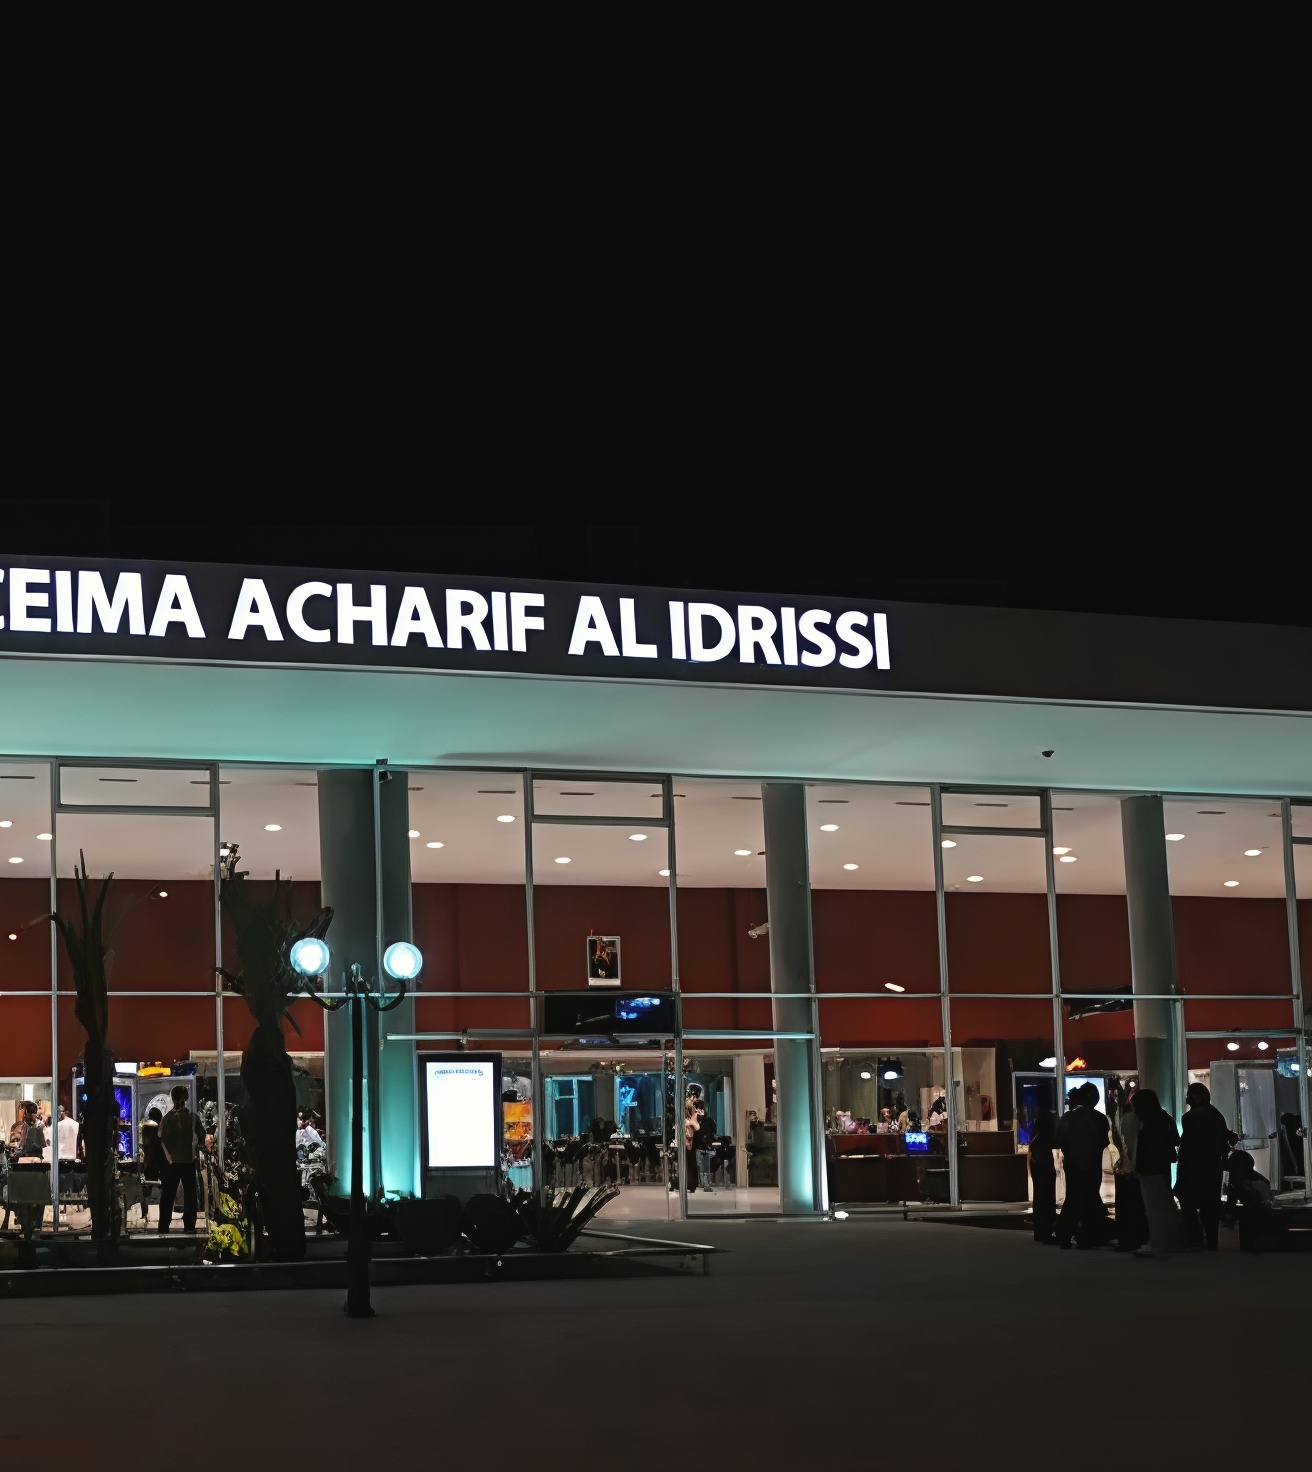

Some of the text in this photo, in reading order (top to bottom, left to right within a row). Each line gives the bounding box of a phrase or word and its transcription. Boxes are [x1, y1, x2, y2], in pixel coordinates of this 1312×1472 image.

[227, 577, 545, 653] ACHARIF
[567, 595, 658, 659] AL
[668, 600, 891, 670] IDRISSI
